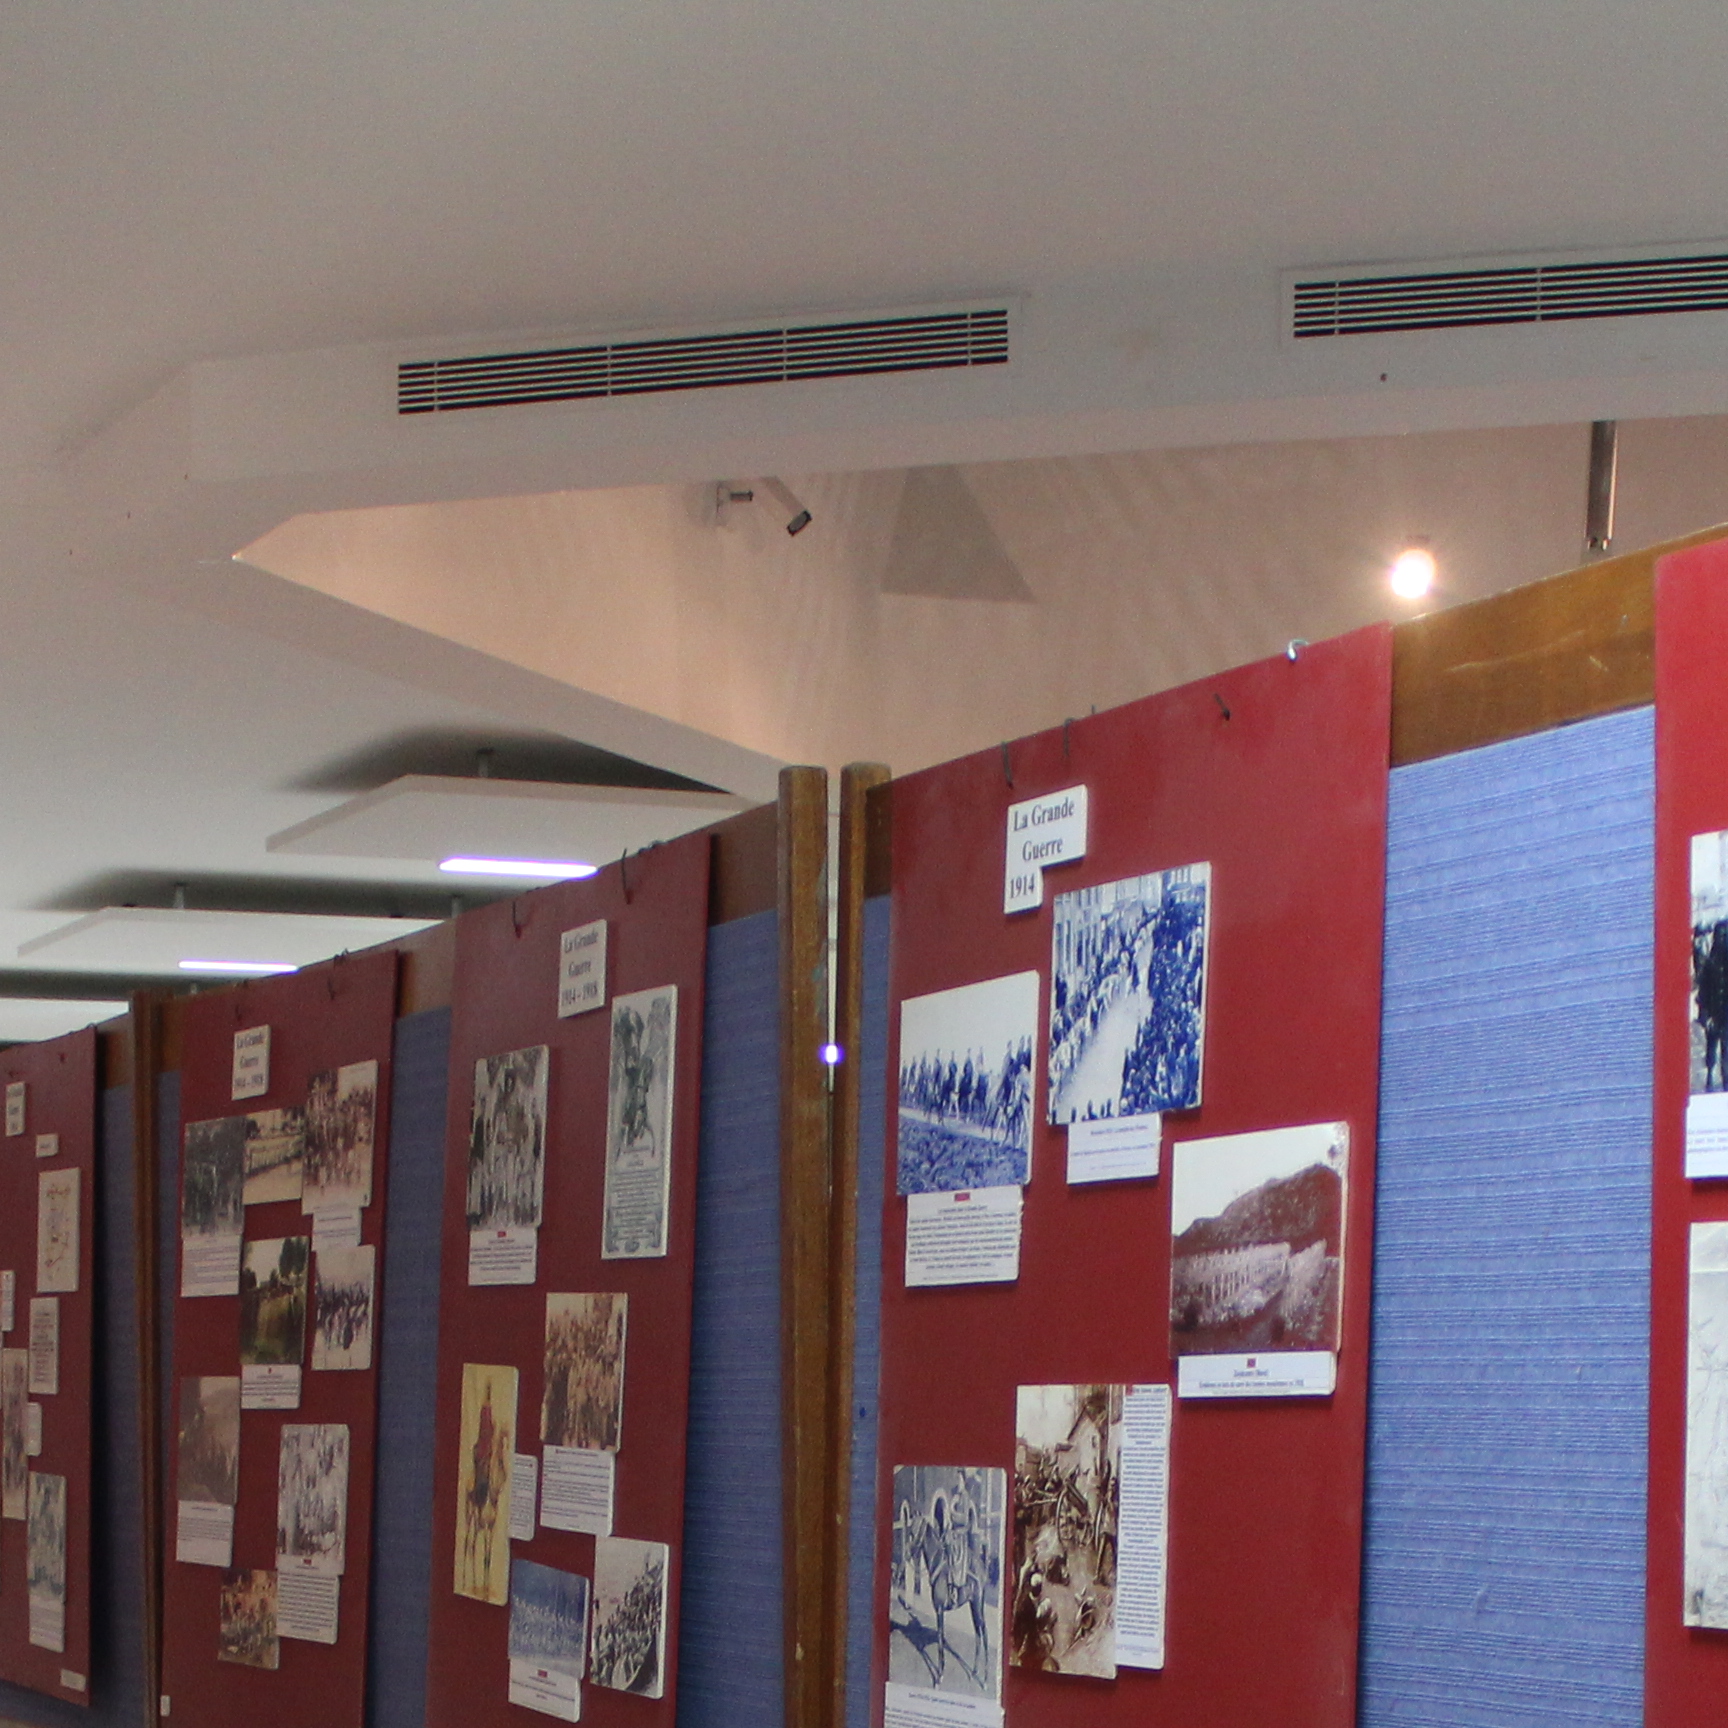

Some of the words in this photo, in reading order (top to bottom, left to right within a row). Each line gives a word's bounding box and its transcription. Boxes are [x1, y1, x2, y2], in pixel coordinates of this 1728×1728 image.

[1014, 810, 1028, 832] La
[1031, 796, 1075, 826] Grande
[1022, 838, 1063, 862] Guerre
[1010, 873, 1034, 899] 1914
